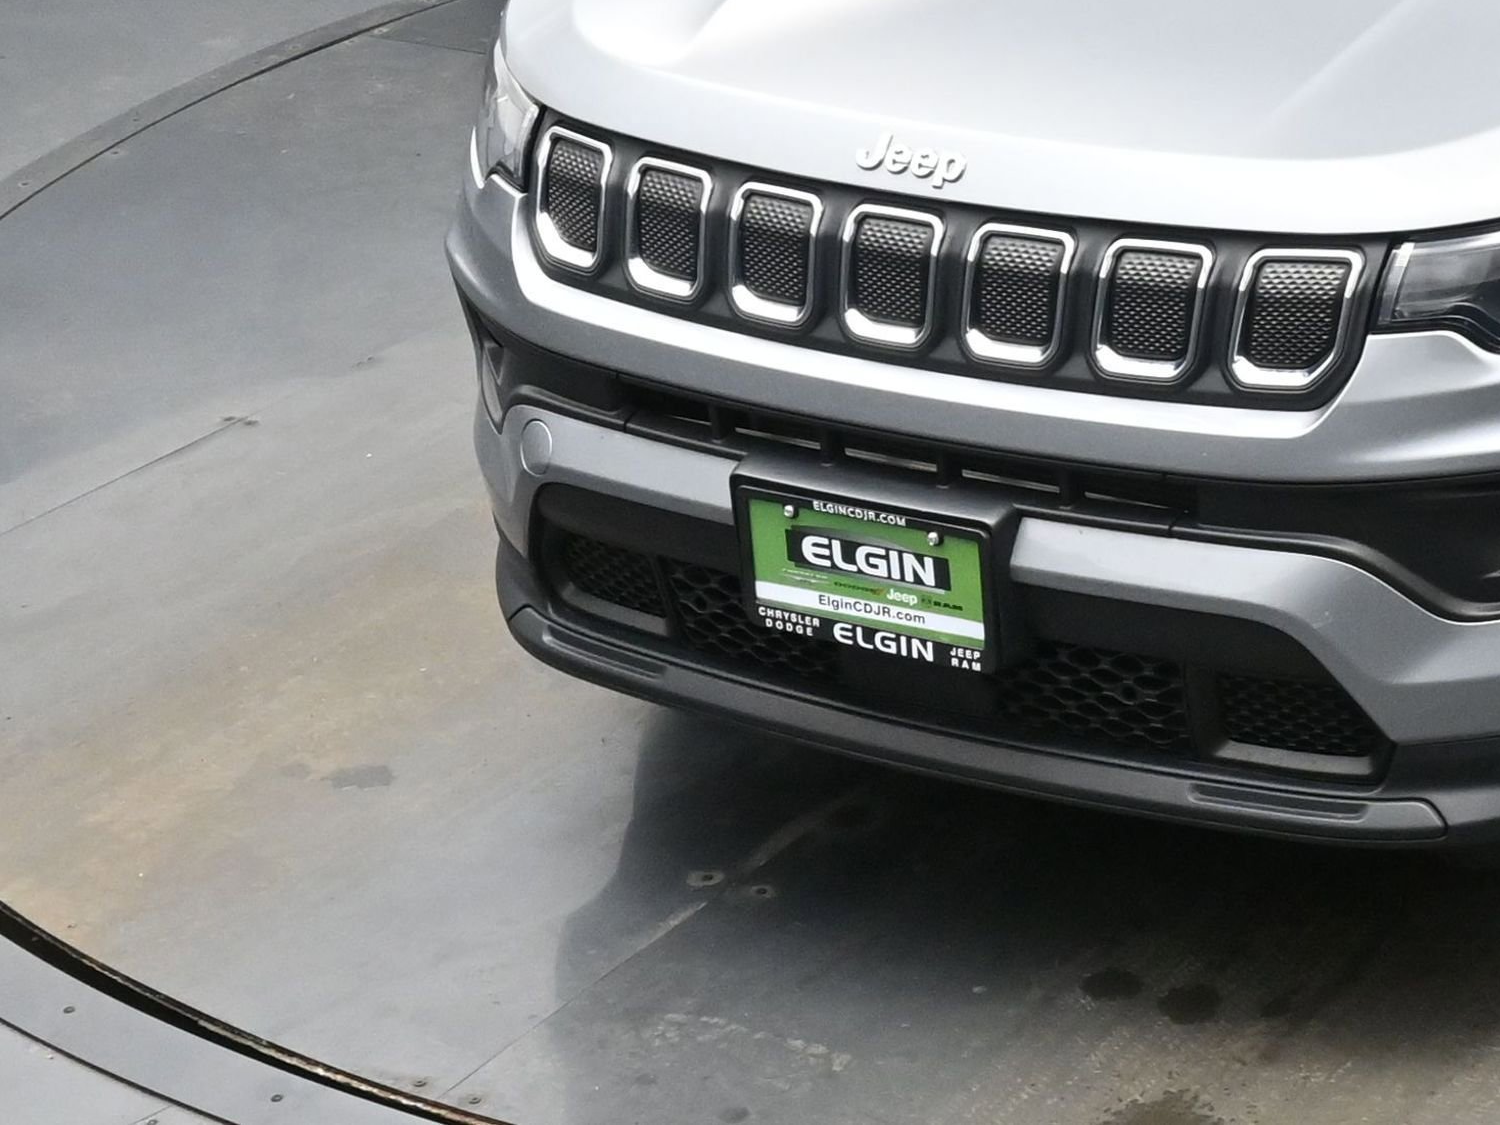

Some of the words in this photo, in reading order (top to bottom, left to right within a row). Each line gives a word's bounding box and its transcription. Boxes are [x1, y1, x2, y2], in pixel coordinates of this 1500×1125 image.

[855, 132, 968, 189] Jeep
[812, 500, 907, 526] ELGINCDJR.COM
[801, 535, 936, 587] ELGIN
[886, 588, 918, 606] Jeep
[758, 606, 821, 628] CHRYSLER
[818, 594, 926, 625] ElginCDJR.com
[765, 618, 814, 637] DODGE
[833, 622, 935, 663] ELGIN
[950, 647, 982, 661] JEEP
[951, 657, 982, 672] RAM
